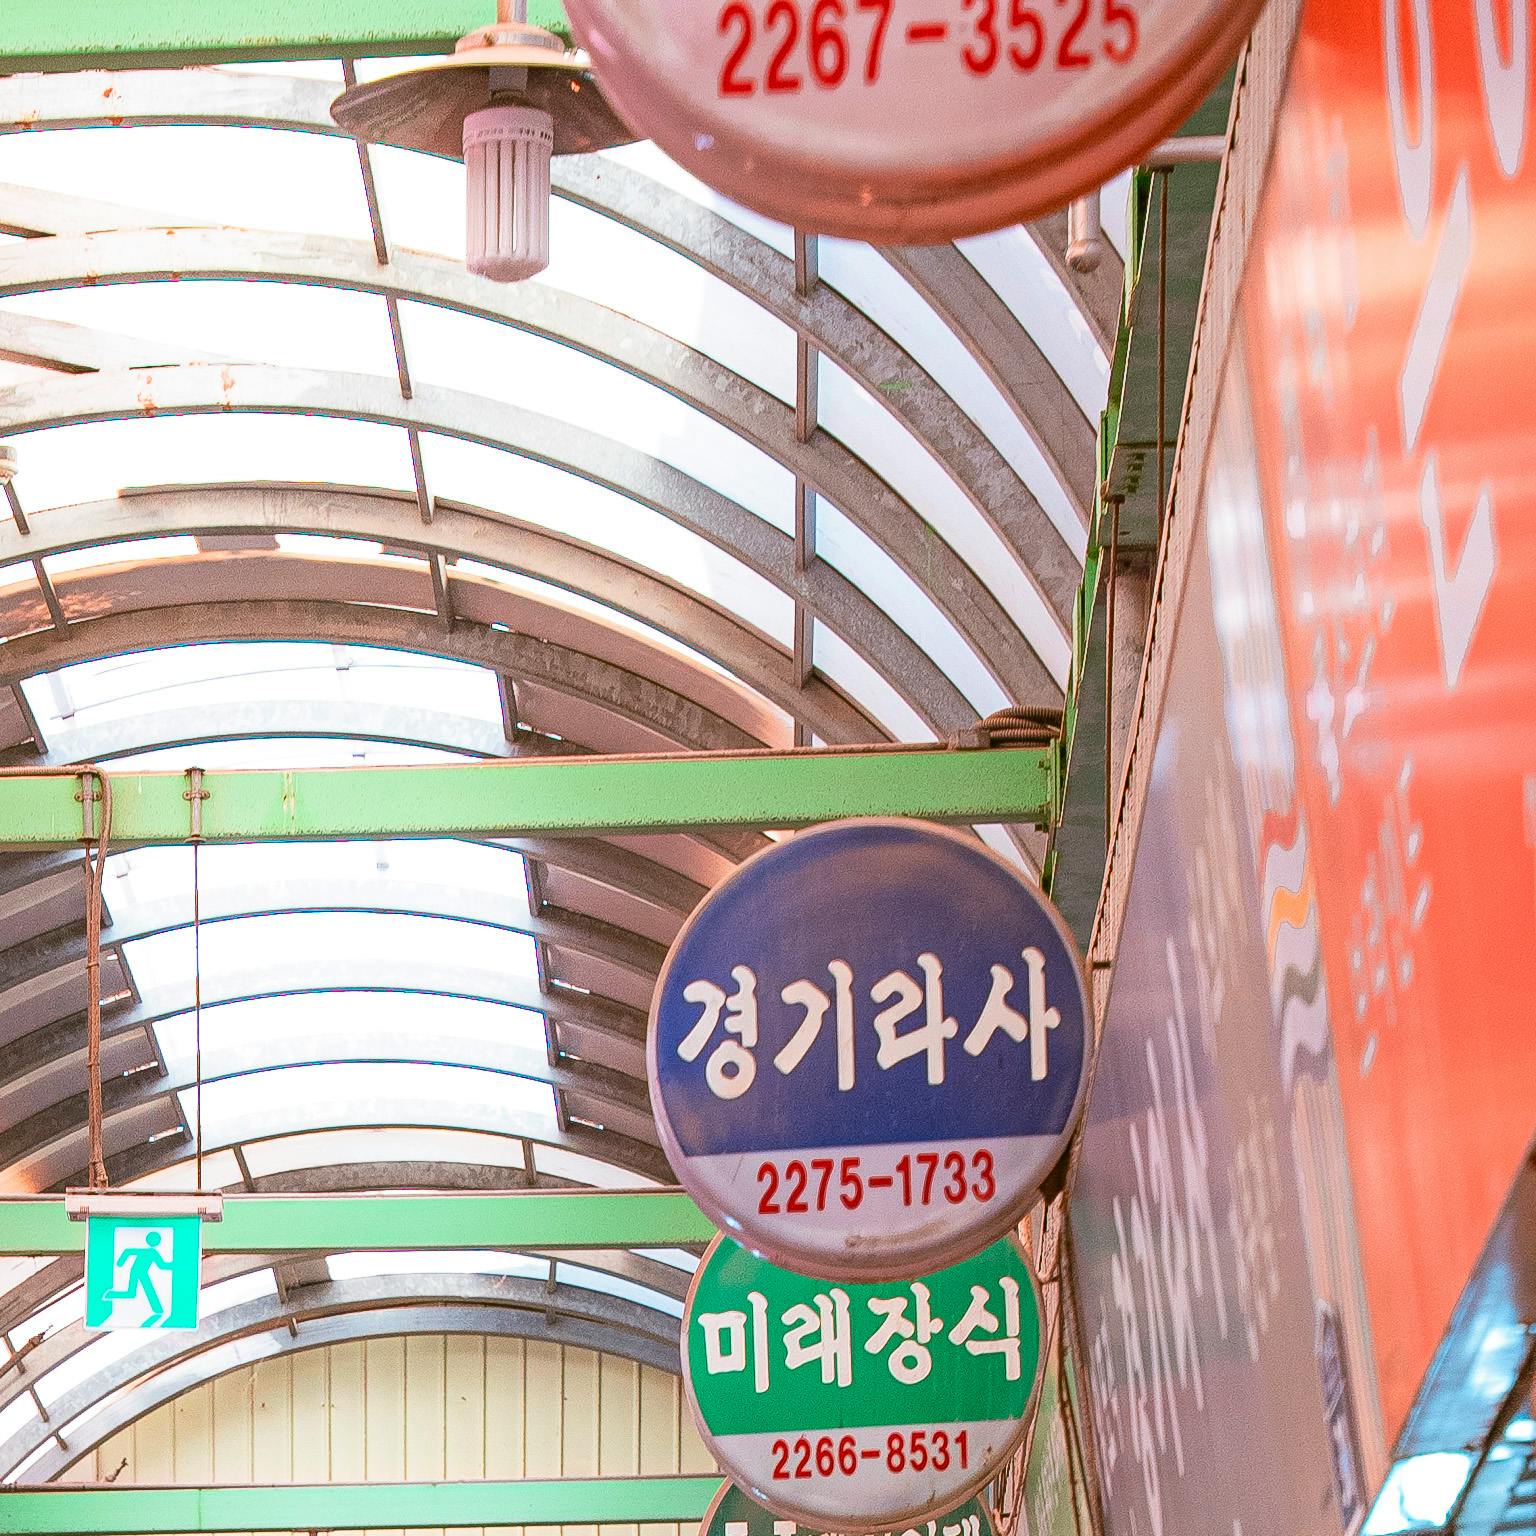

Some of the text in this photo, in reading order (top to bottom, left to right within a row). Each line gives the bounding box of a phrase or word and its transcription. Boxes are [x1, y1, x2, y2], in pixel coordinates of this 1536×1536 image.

[719, 0, 1140, 98] 2267-3525
[676, 946, 1061, 1099] 경기라사
[756, 1148, 997, 1214] 2275-1733
[698, 1275, 1022, 1394] 미래장식
[771, 1430, 970, 1481] 2266-8531
